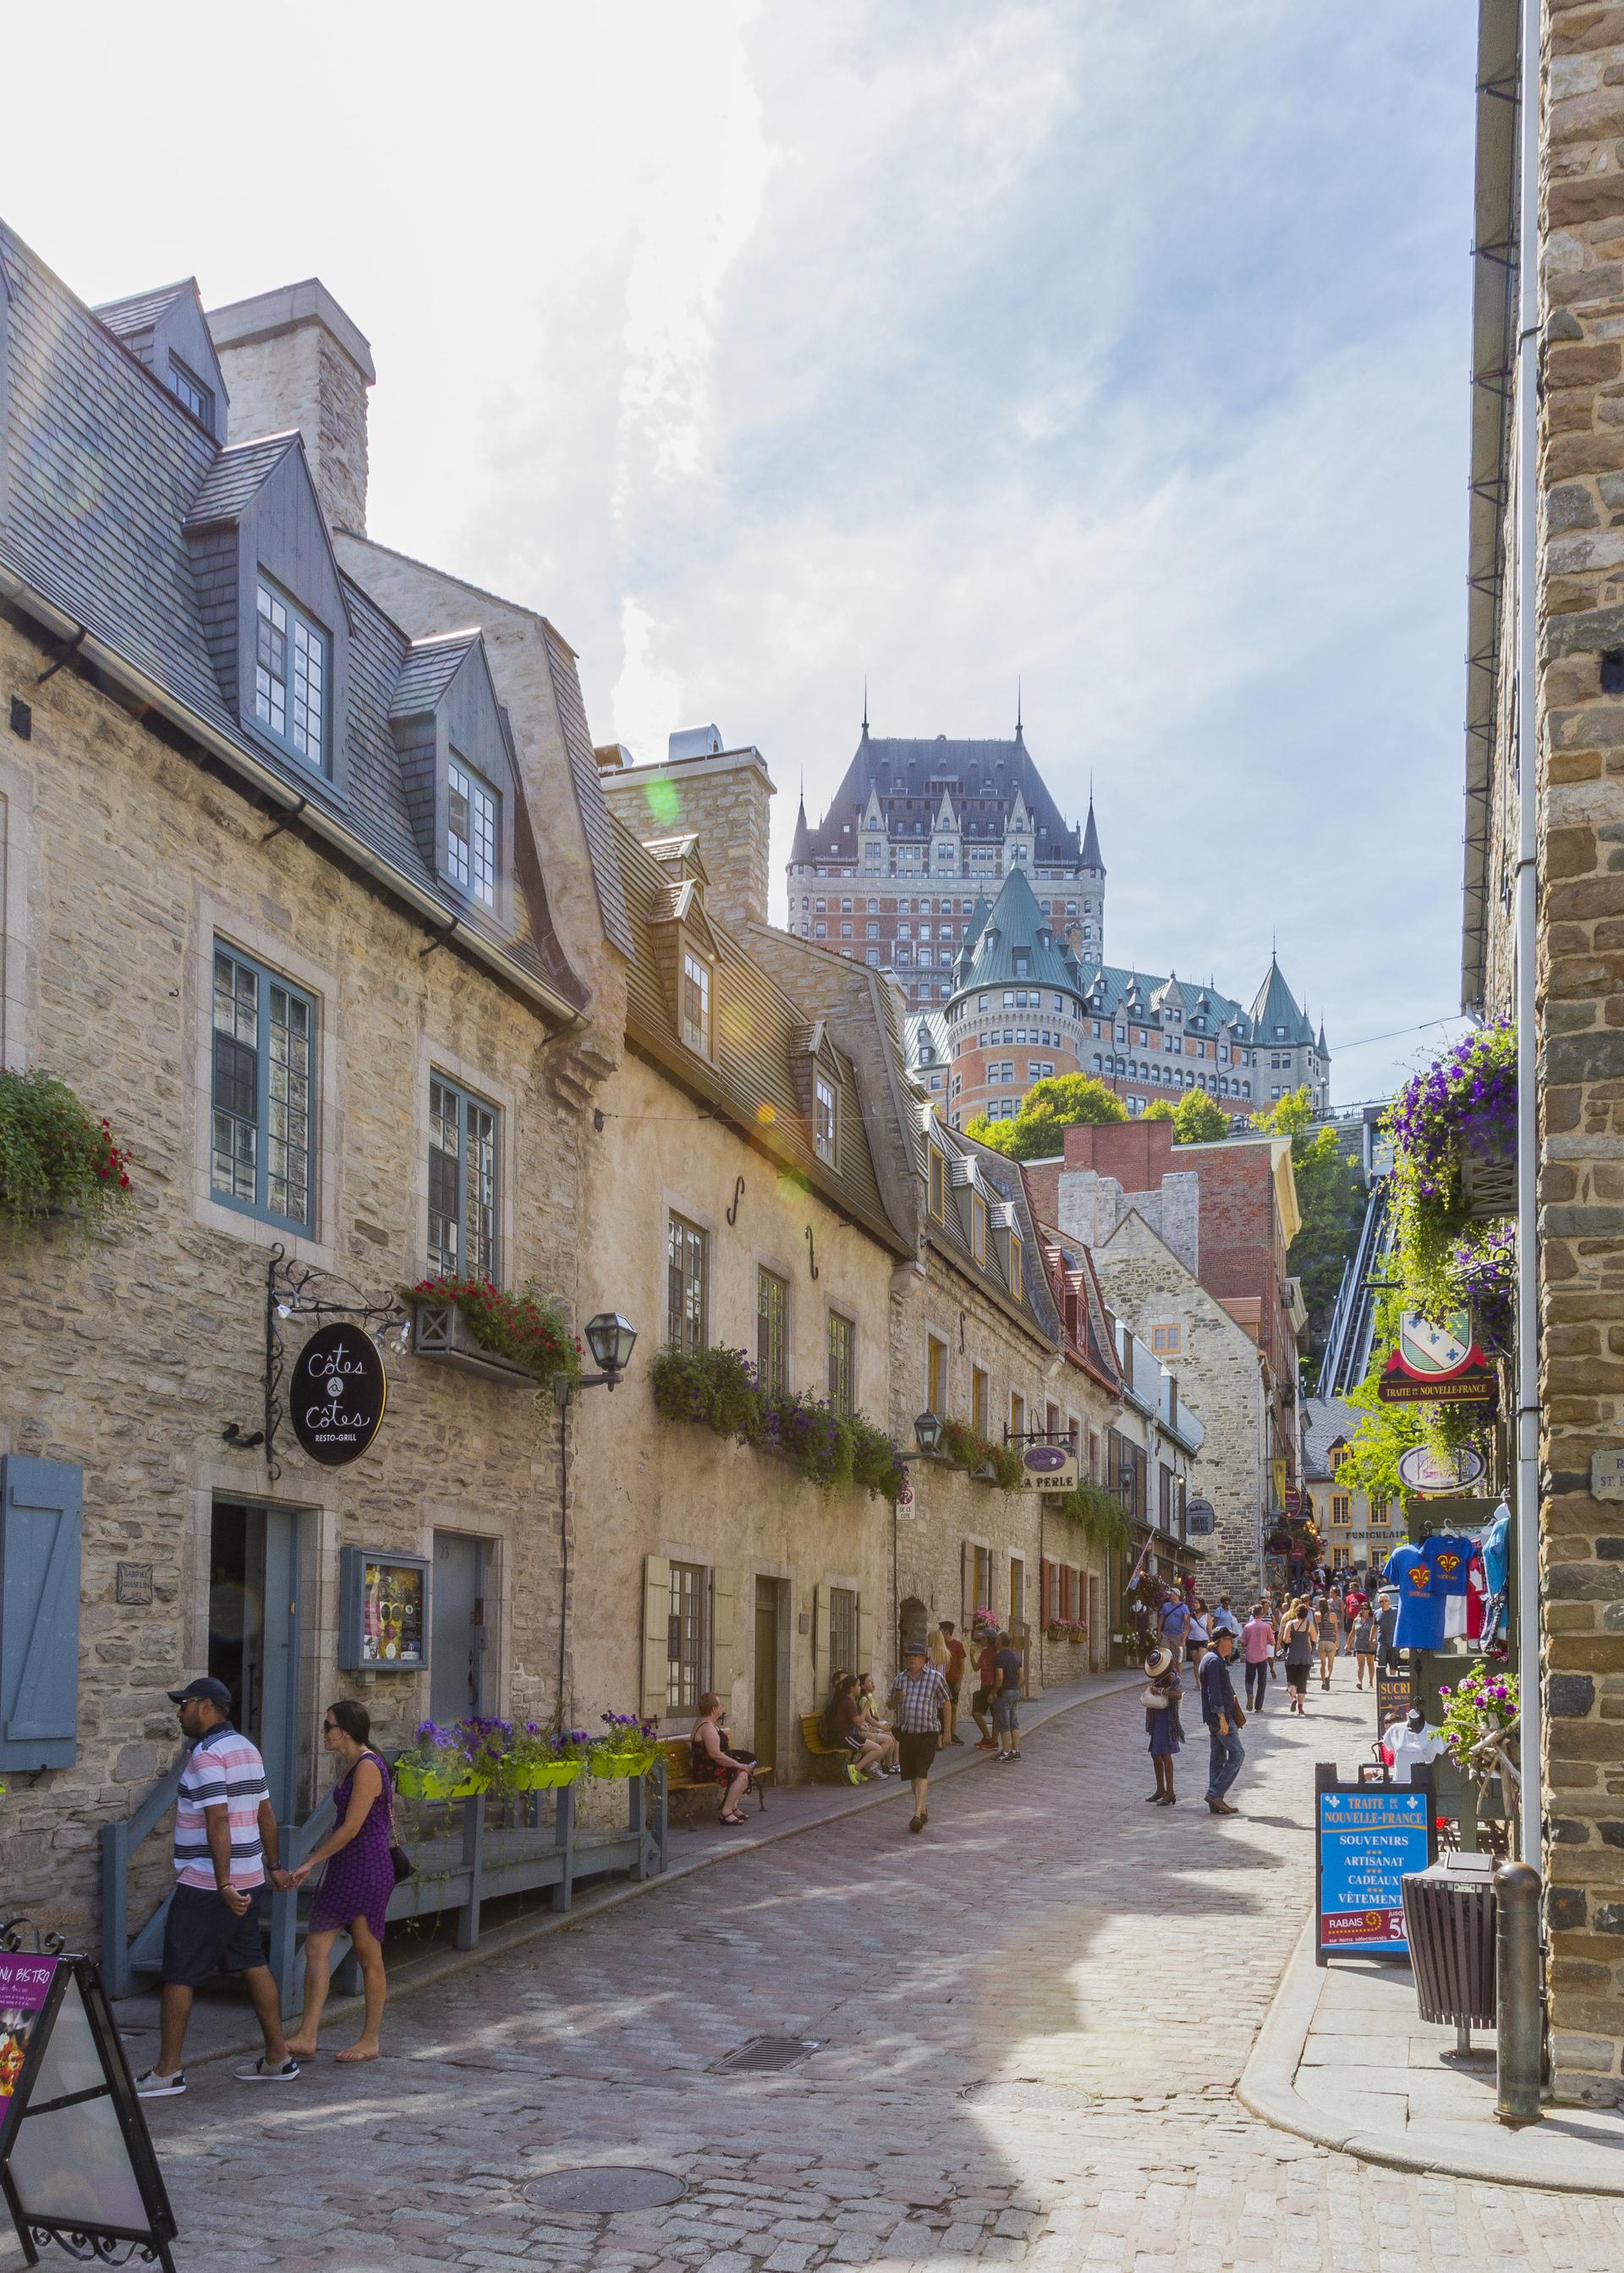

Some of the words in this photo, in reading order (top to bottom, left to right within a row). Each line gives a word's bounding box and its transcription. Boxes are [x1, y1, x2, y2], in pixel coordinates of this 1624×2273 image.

[308, 1342, 367, 1377] Côtes
[1386, 1387, 1411, 1397] TRAITE
[1420, 1384, 1486, 1395] NOUVELLE-FRANCE
[306, 1400, 370, 1429] Côtes
[315, 1434, 357, 1442] RESTO-GRILL
[1021, 1478, 1033, 1488] A
[1036, 1476, 1073, 1487] PERLE
[1600, 1475, 1616, 1487] ST.
[1348, 1798, 1385, 1809] TRAITE
[1325, 1812, 1424, 1825] NOUVELLE-FRANCE
[1339, 1835, 1409, 1847] SOUVENIRS
[1343, 1856, 1405, 1867] ARTISANAT
[1348, 1875, 1400, 1886] CADEAUX
[1329, 1917, 1363, 1929] RABAIS
[15, 1968, 50, 1984] BISTRO
